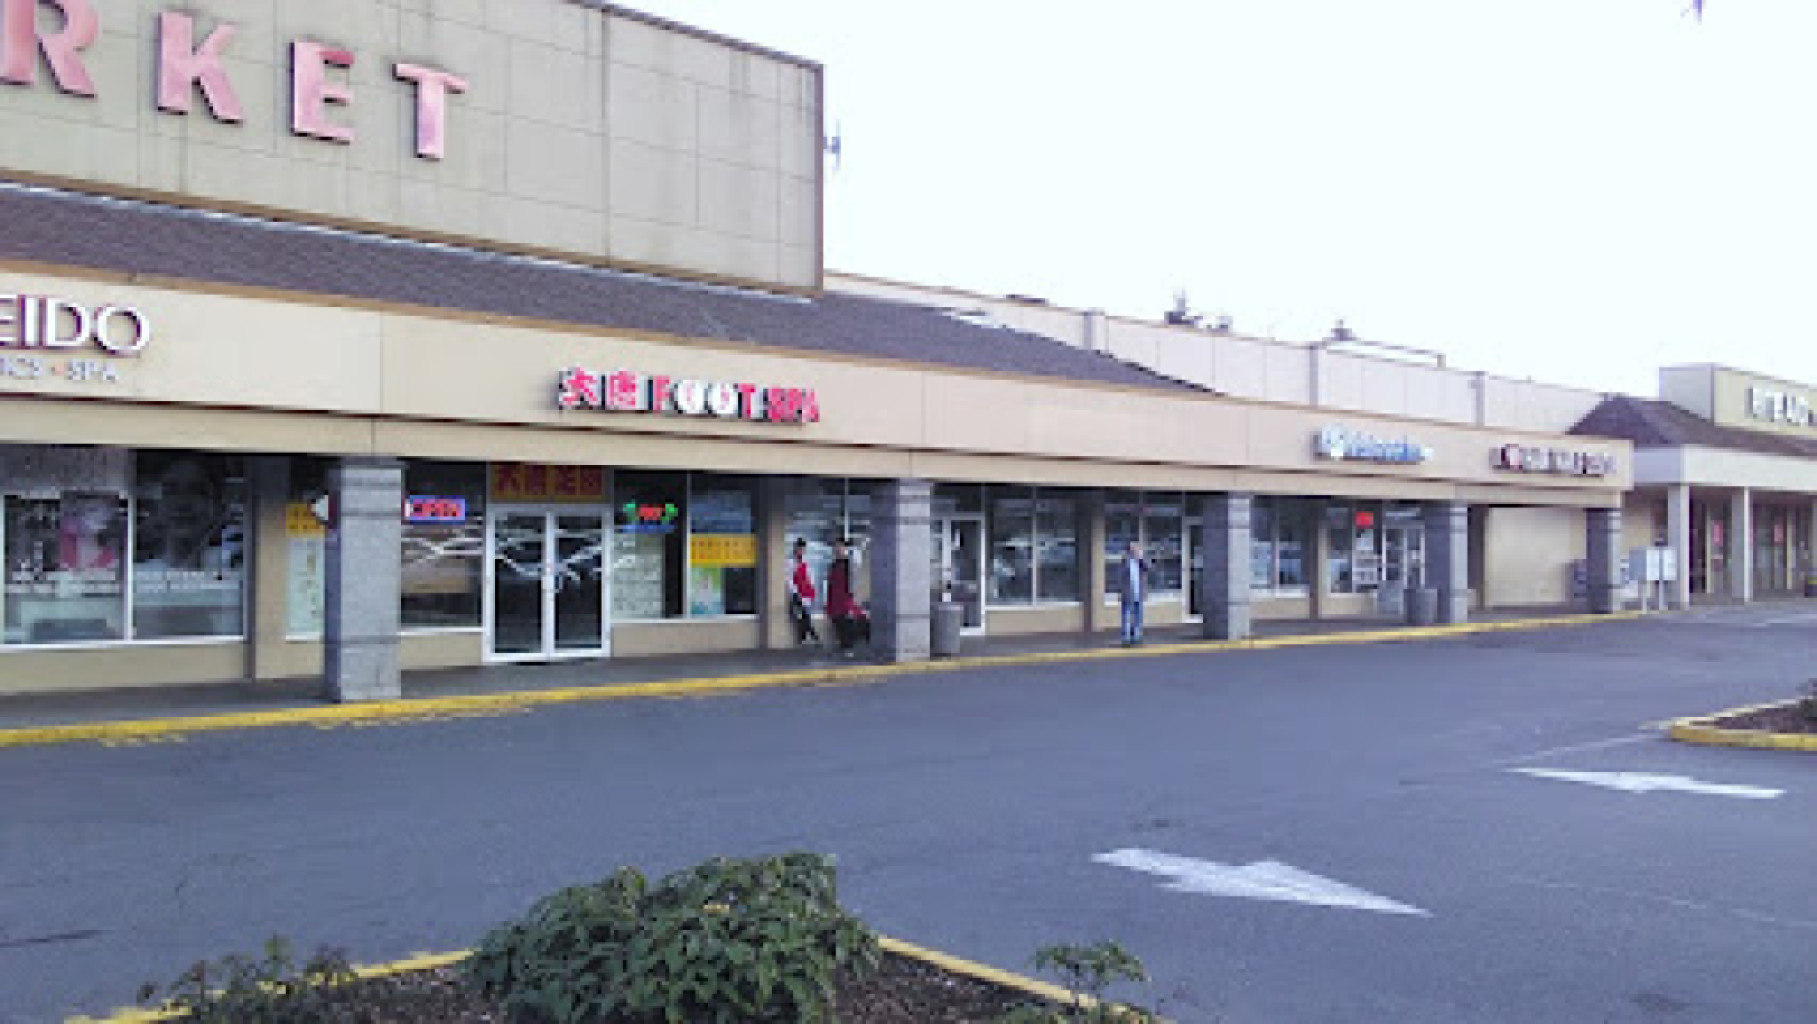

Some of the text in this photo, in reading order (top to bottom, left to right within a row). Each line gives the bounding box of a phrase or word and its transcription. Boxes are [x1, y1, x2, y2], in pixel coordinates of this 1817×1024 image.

[0, 0, 470, 160] RKET
[0, 294, 150, 356] EIDO
[651, 374, 758, 418] FOOT
